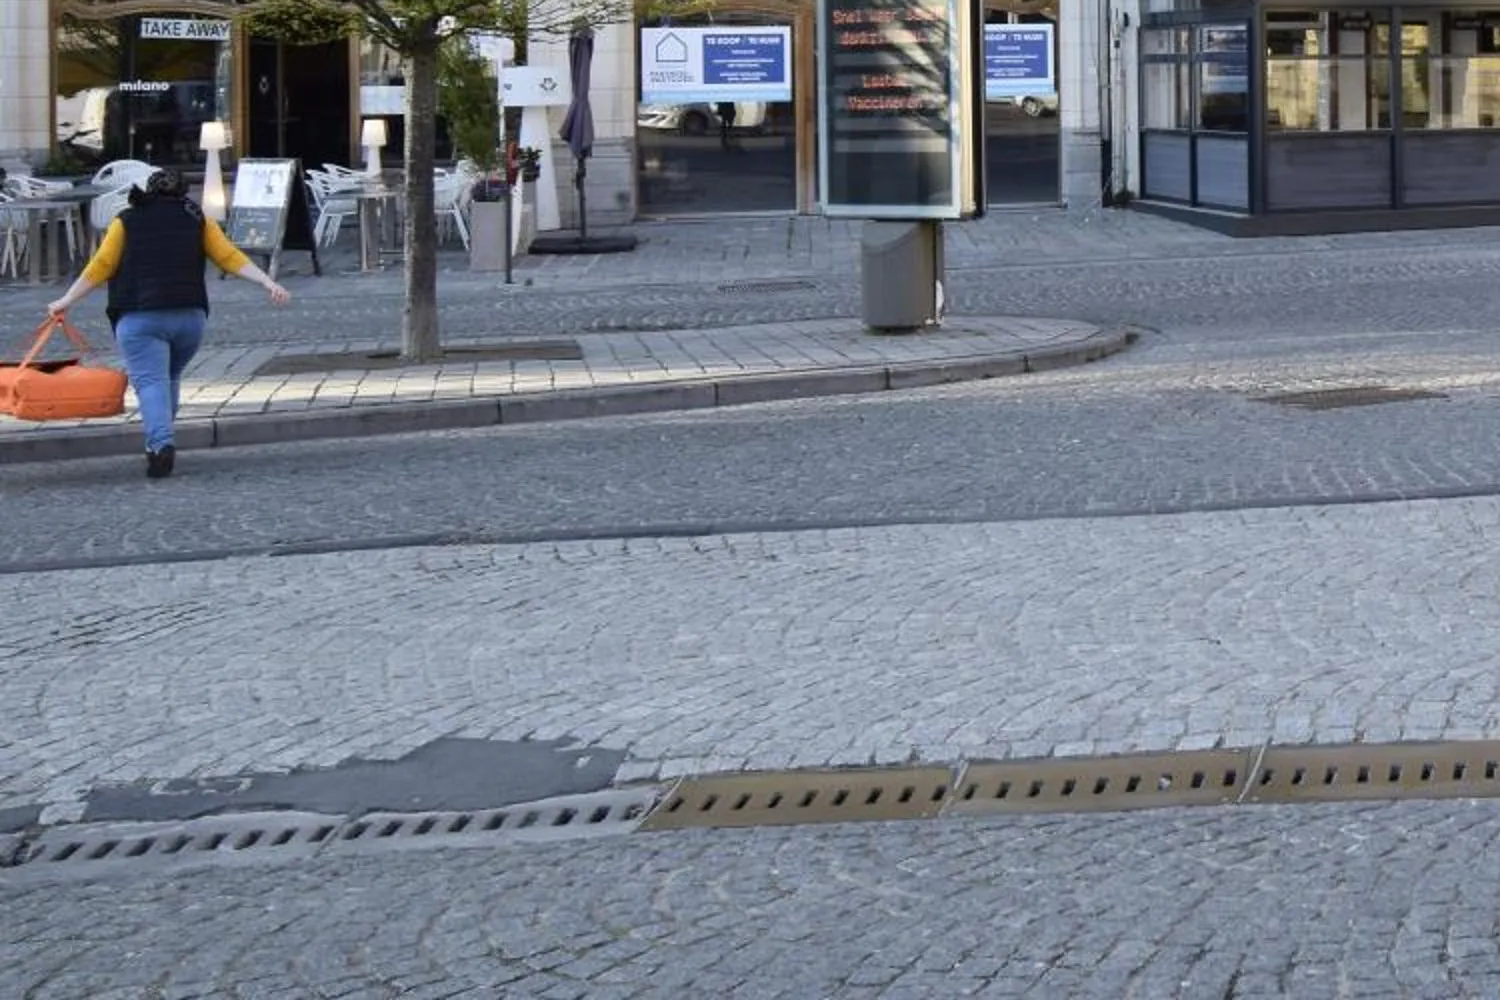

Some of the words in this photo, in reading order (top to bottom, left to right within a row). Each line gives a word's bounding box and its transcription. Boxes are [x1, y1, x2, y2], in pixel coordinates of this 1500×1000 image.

[142, 21, 181, 36] TAKE
[186, 23, 230, 38] AWAY
[119, 80, 170, 92] milano
